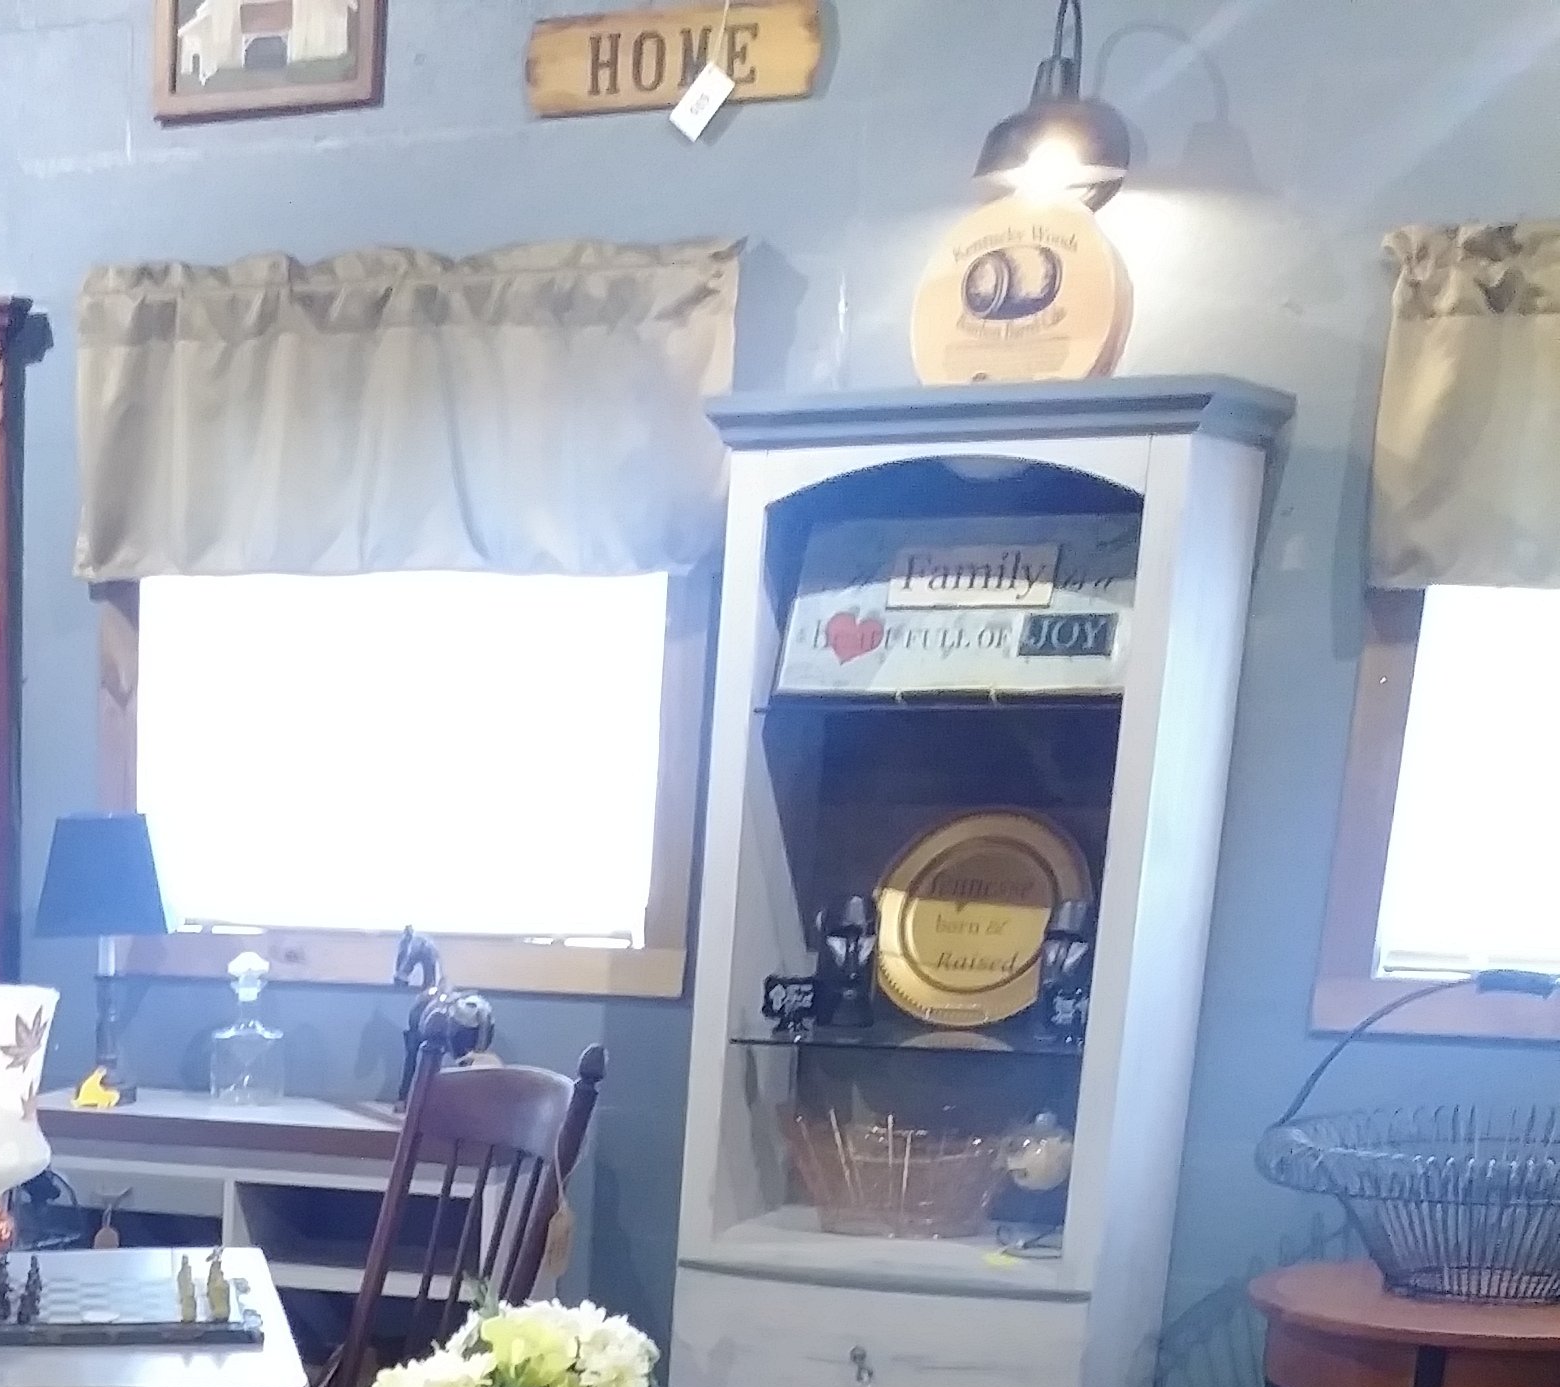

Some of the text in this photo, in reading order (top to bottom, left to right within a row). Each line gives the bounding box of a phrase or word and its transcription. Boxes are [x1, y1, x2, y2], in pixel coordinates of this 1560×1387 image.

[587, 22, 759, 97] HOME
[902, 550, 1051, 600] Family
[976, 626, 1013, 650] OF
[1027, 617, 1108, 650] JOY
[936, 950, 1021, 973] Raised
